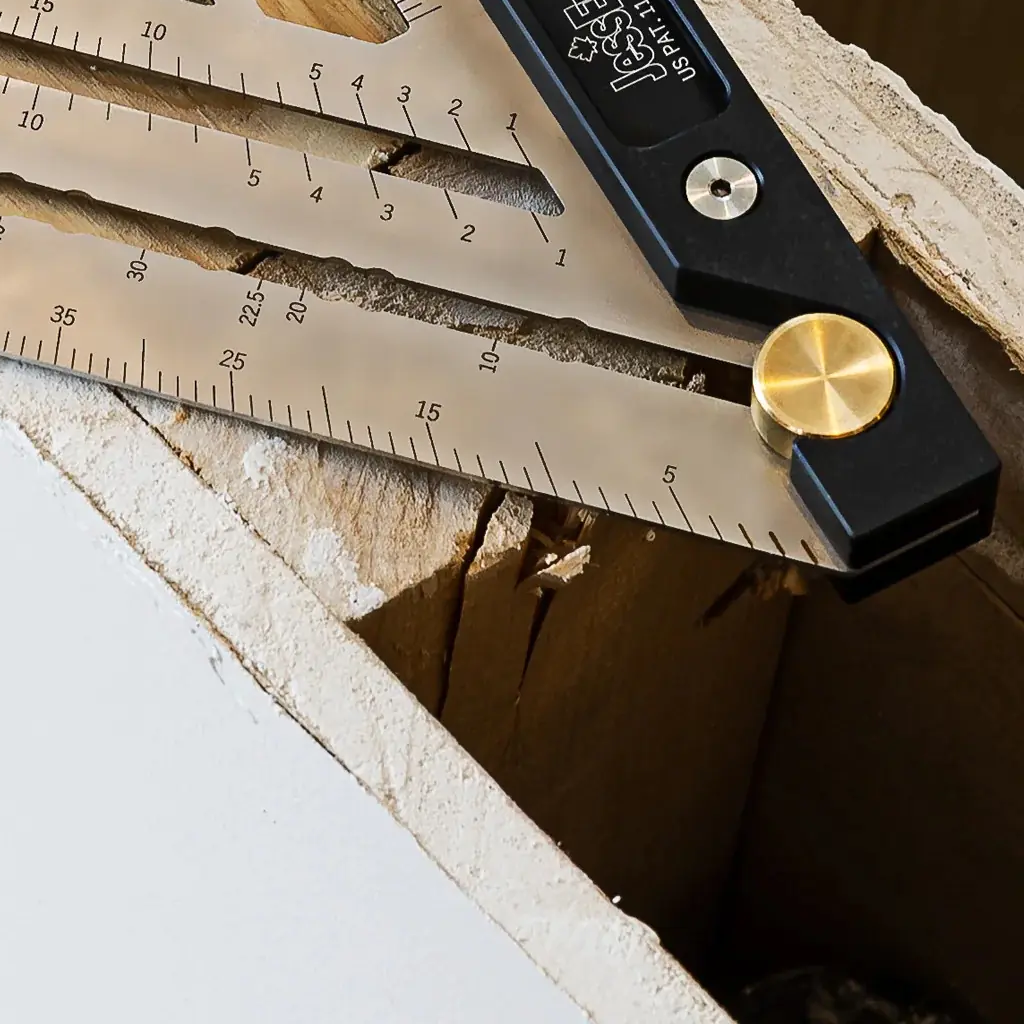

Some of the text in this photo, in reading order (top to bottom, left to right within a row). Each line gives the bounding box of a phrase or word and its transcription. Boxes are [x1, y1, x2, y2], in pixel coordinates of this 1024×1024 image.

[140, 21, 167, 41] 10
[308, 62, 324, 81] 5
[351, 74, 364, 92] 4
[396, 85, 412, 103] 3
[447, 98, 463, 117] 2
[505, 112, 518, 131] 1
[648, 17, 681, 57] PAT.
[672, 56, 696, 82] US
[17, 110, 44, 131] 10
[247, 168, 262, 187] 5
[309, 186, 323, 204] 4
[379, 203, 395, 222] 3
[460, 224, 476, 243] 2
[555, 248, 566, 267] 1
[126, 260, 148, 283] 30
[238, 290, 265, 327] 22.5
[285, 301, 308, 325] 20
[478, 351, 500, 374] 10
[50, 304, 77, 326] 35
[218, 349, 247, 371] 25
[414, 400, 442, 422] 15
[662, 464, 677, 484] 5
